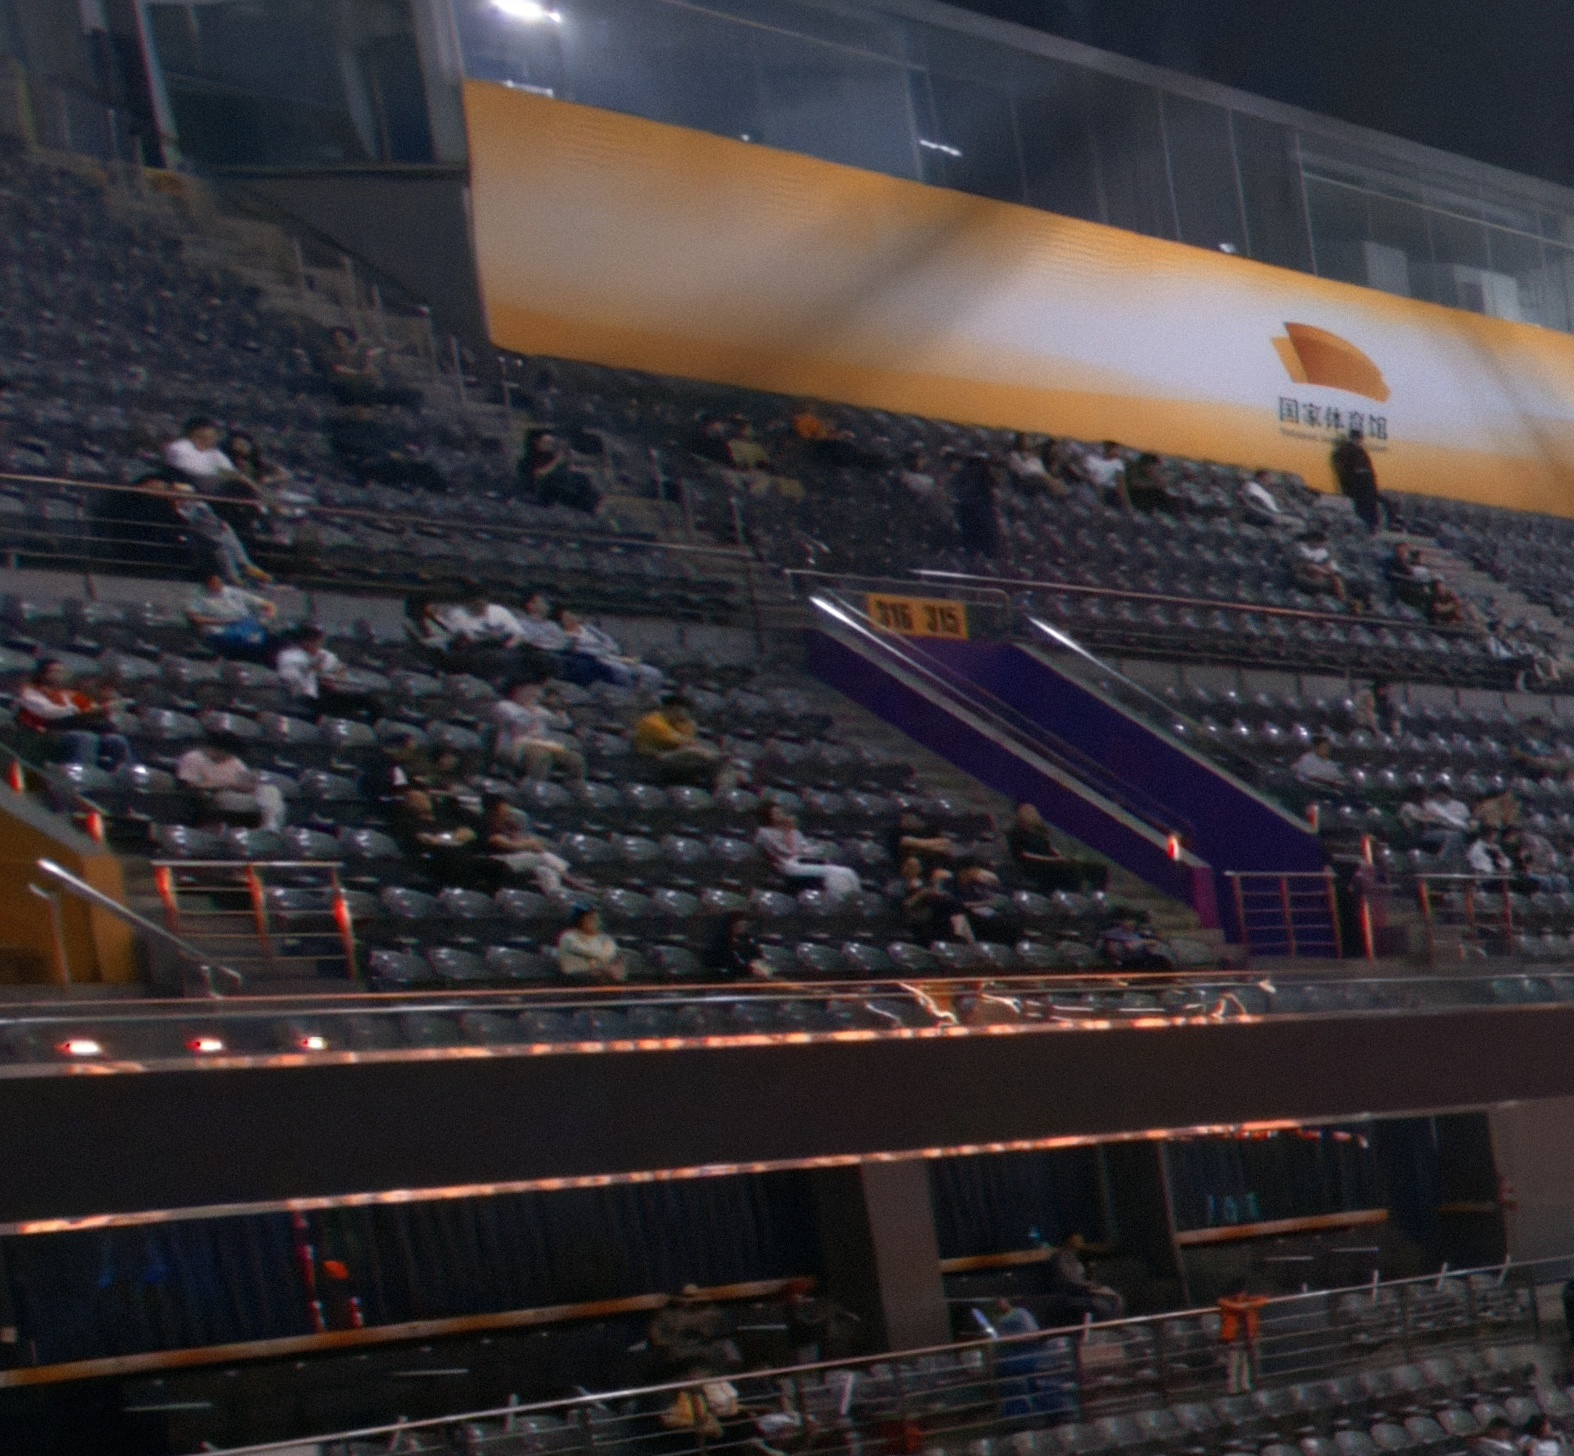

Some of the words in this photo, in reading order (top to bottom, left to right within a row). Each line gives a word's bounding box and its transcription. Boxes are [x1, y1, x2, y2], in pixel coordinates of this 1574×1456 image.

[1279, 396, 1388, 440] 国家体育馆
